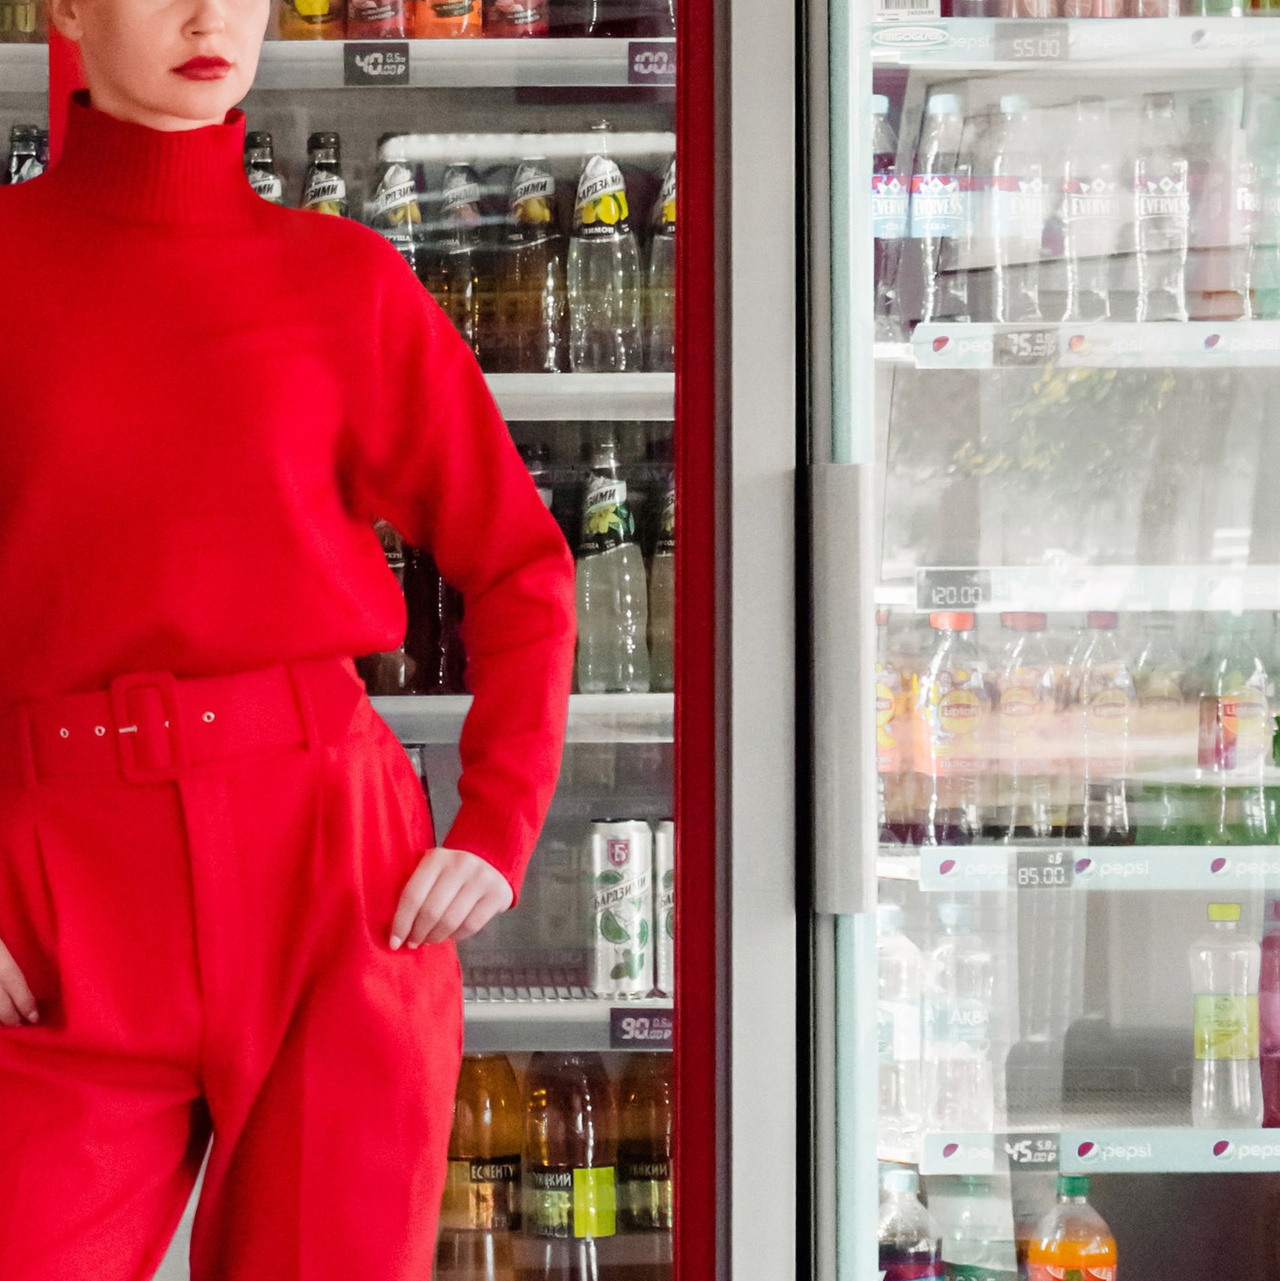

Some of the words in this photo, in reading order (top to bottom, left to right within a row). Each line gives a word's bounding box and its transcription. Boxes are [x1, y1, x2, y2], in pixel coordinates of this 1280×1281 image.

[1100, 860, 1149, 877] pepsi
[594, 876, 646, 910] БАРДЗИИ
[1103, 1144, 1152, 1161] pepsi
